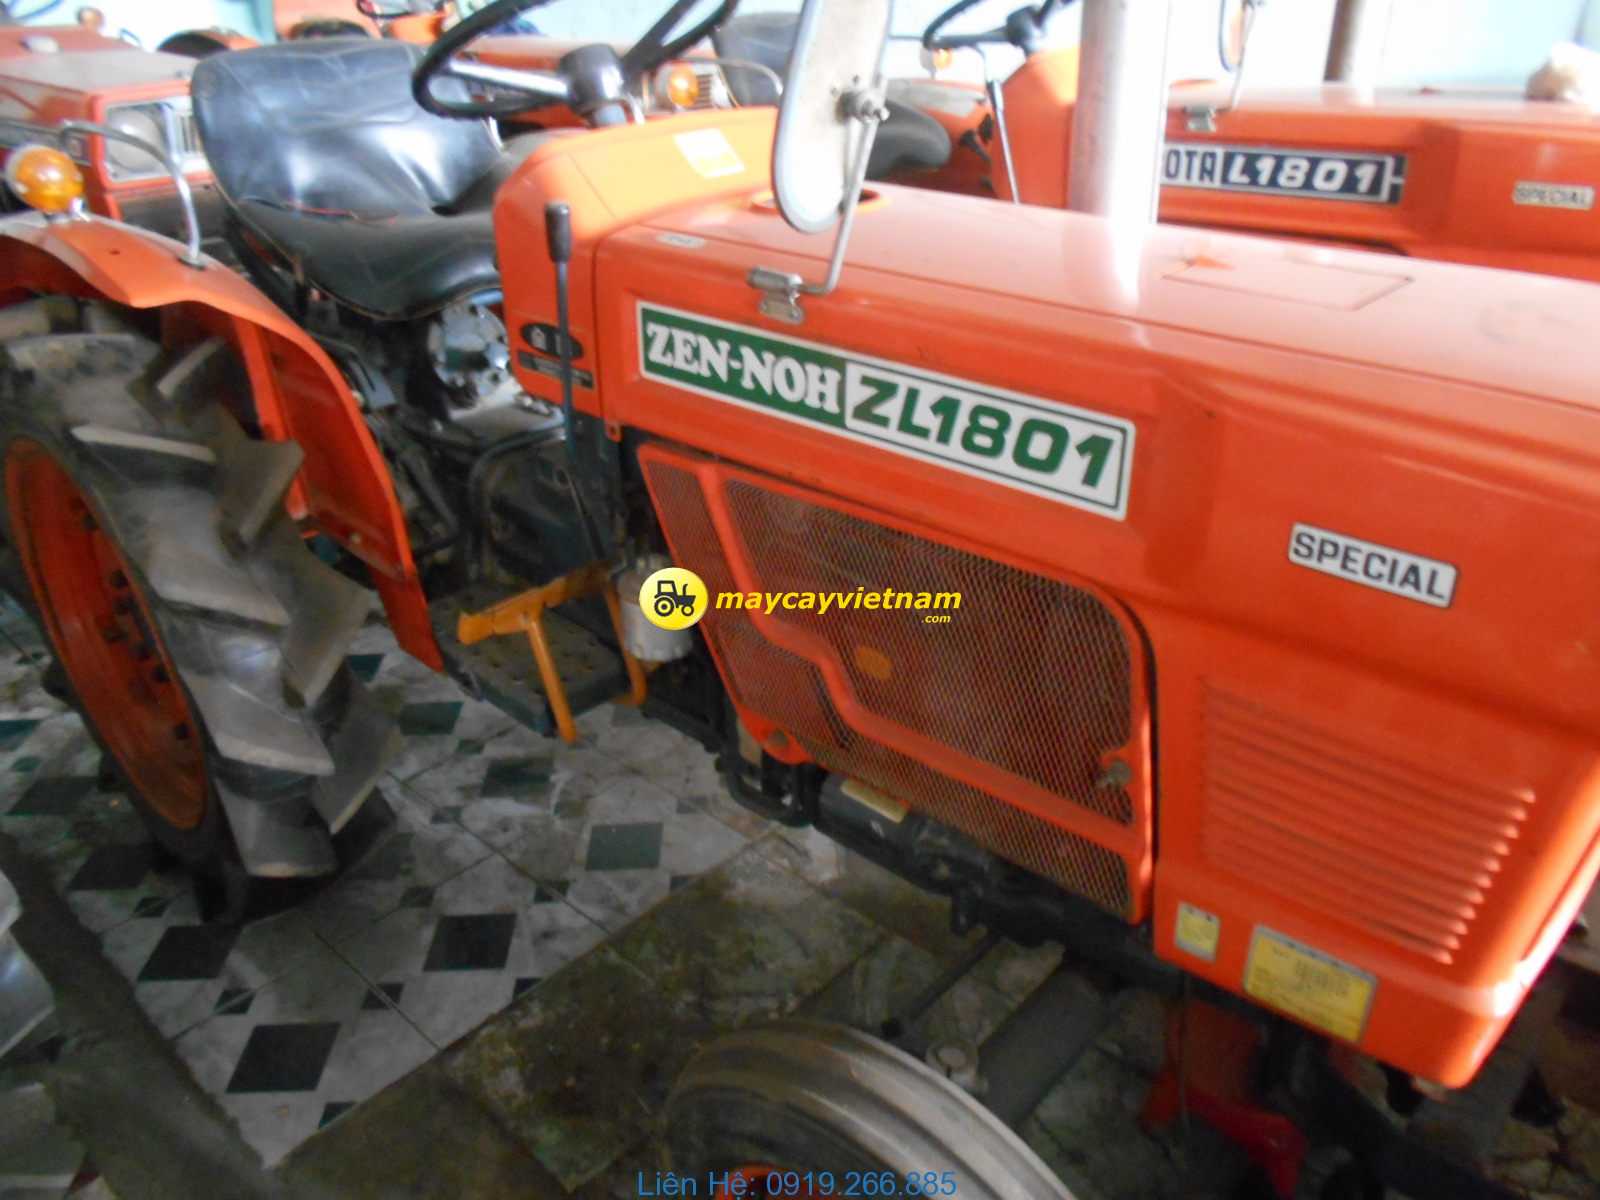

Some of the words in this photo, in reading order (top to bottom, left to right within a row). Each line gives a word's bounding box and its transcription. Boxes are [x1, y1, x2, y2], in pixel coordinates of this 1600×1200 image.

[1227, 153, 1380, 193] L1801
[645, 322, 841, 415] ZEN-NOH
[851, 374, 1115, 490] ZL1801
[1293, 531, 1446, 600] SPECIAL
